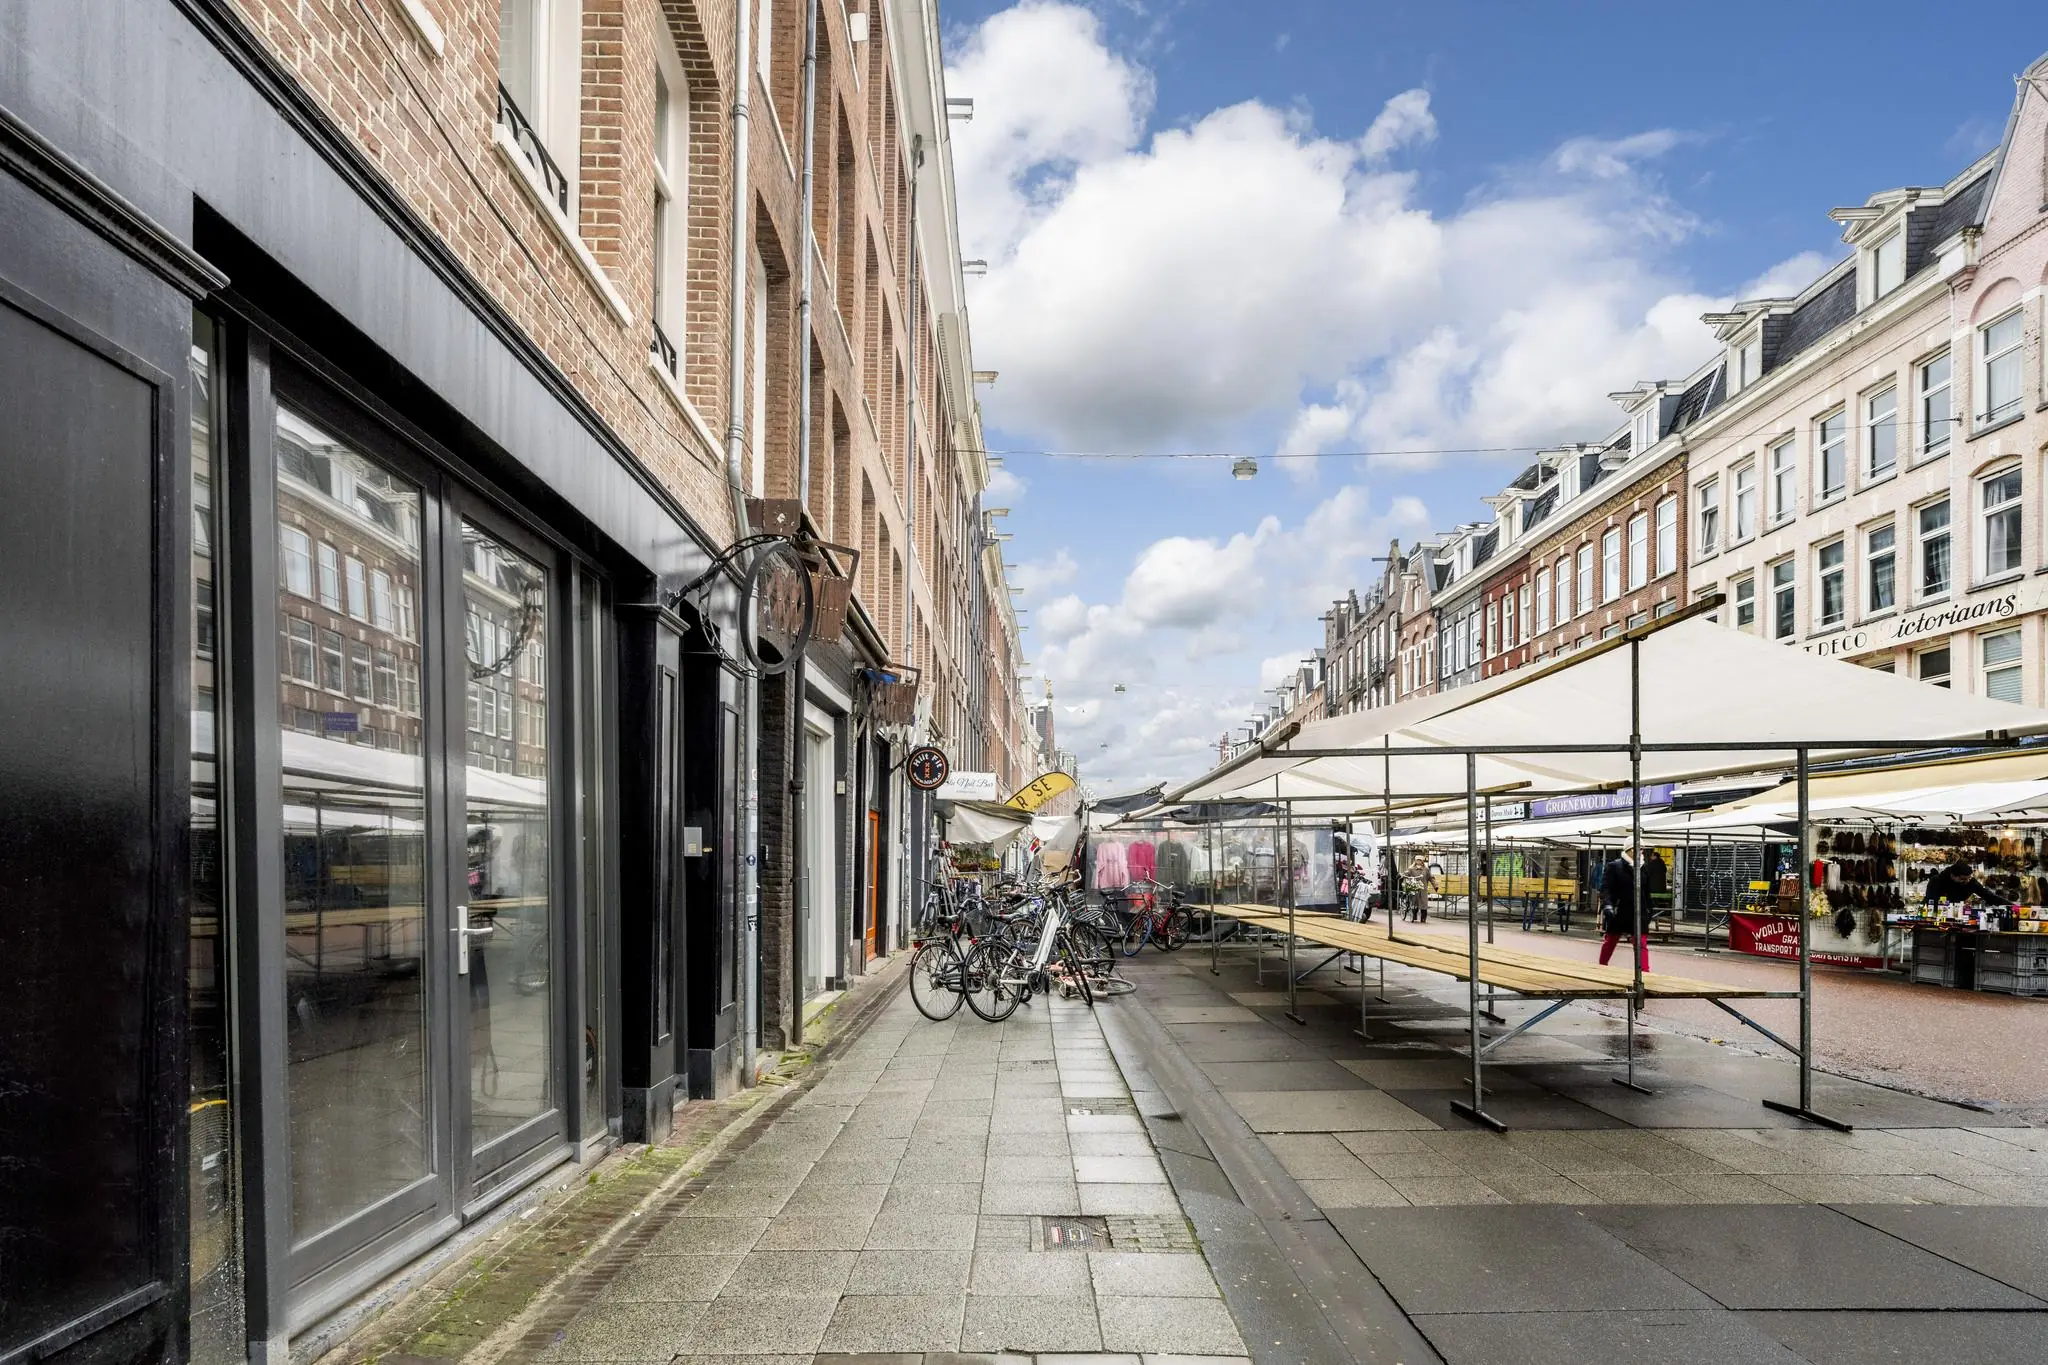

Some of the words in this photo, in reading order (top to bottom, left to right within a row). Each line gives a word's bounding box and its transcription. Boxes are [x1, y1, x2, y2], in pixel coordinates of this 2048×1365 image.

[1818, 632, 1868, 657] DECO
[1891, 594, 2016, 639] ictoriaans
[1545, 795, 1608, 813] GROENEWOUD
[1611, 789, 1651, 808] bedteiel
[1752, 922, 1784, 941] WORLD
[1788, 921, 1801, 933] WI
[1755, 942, 1792, 955] TRANSPORT
